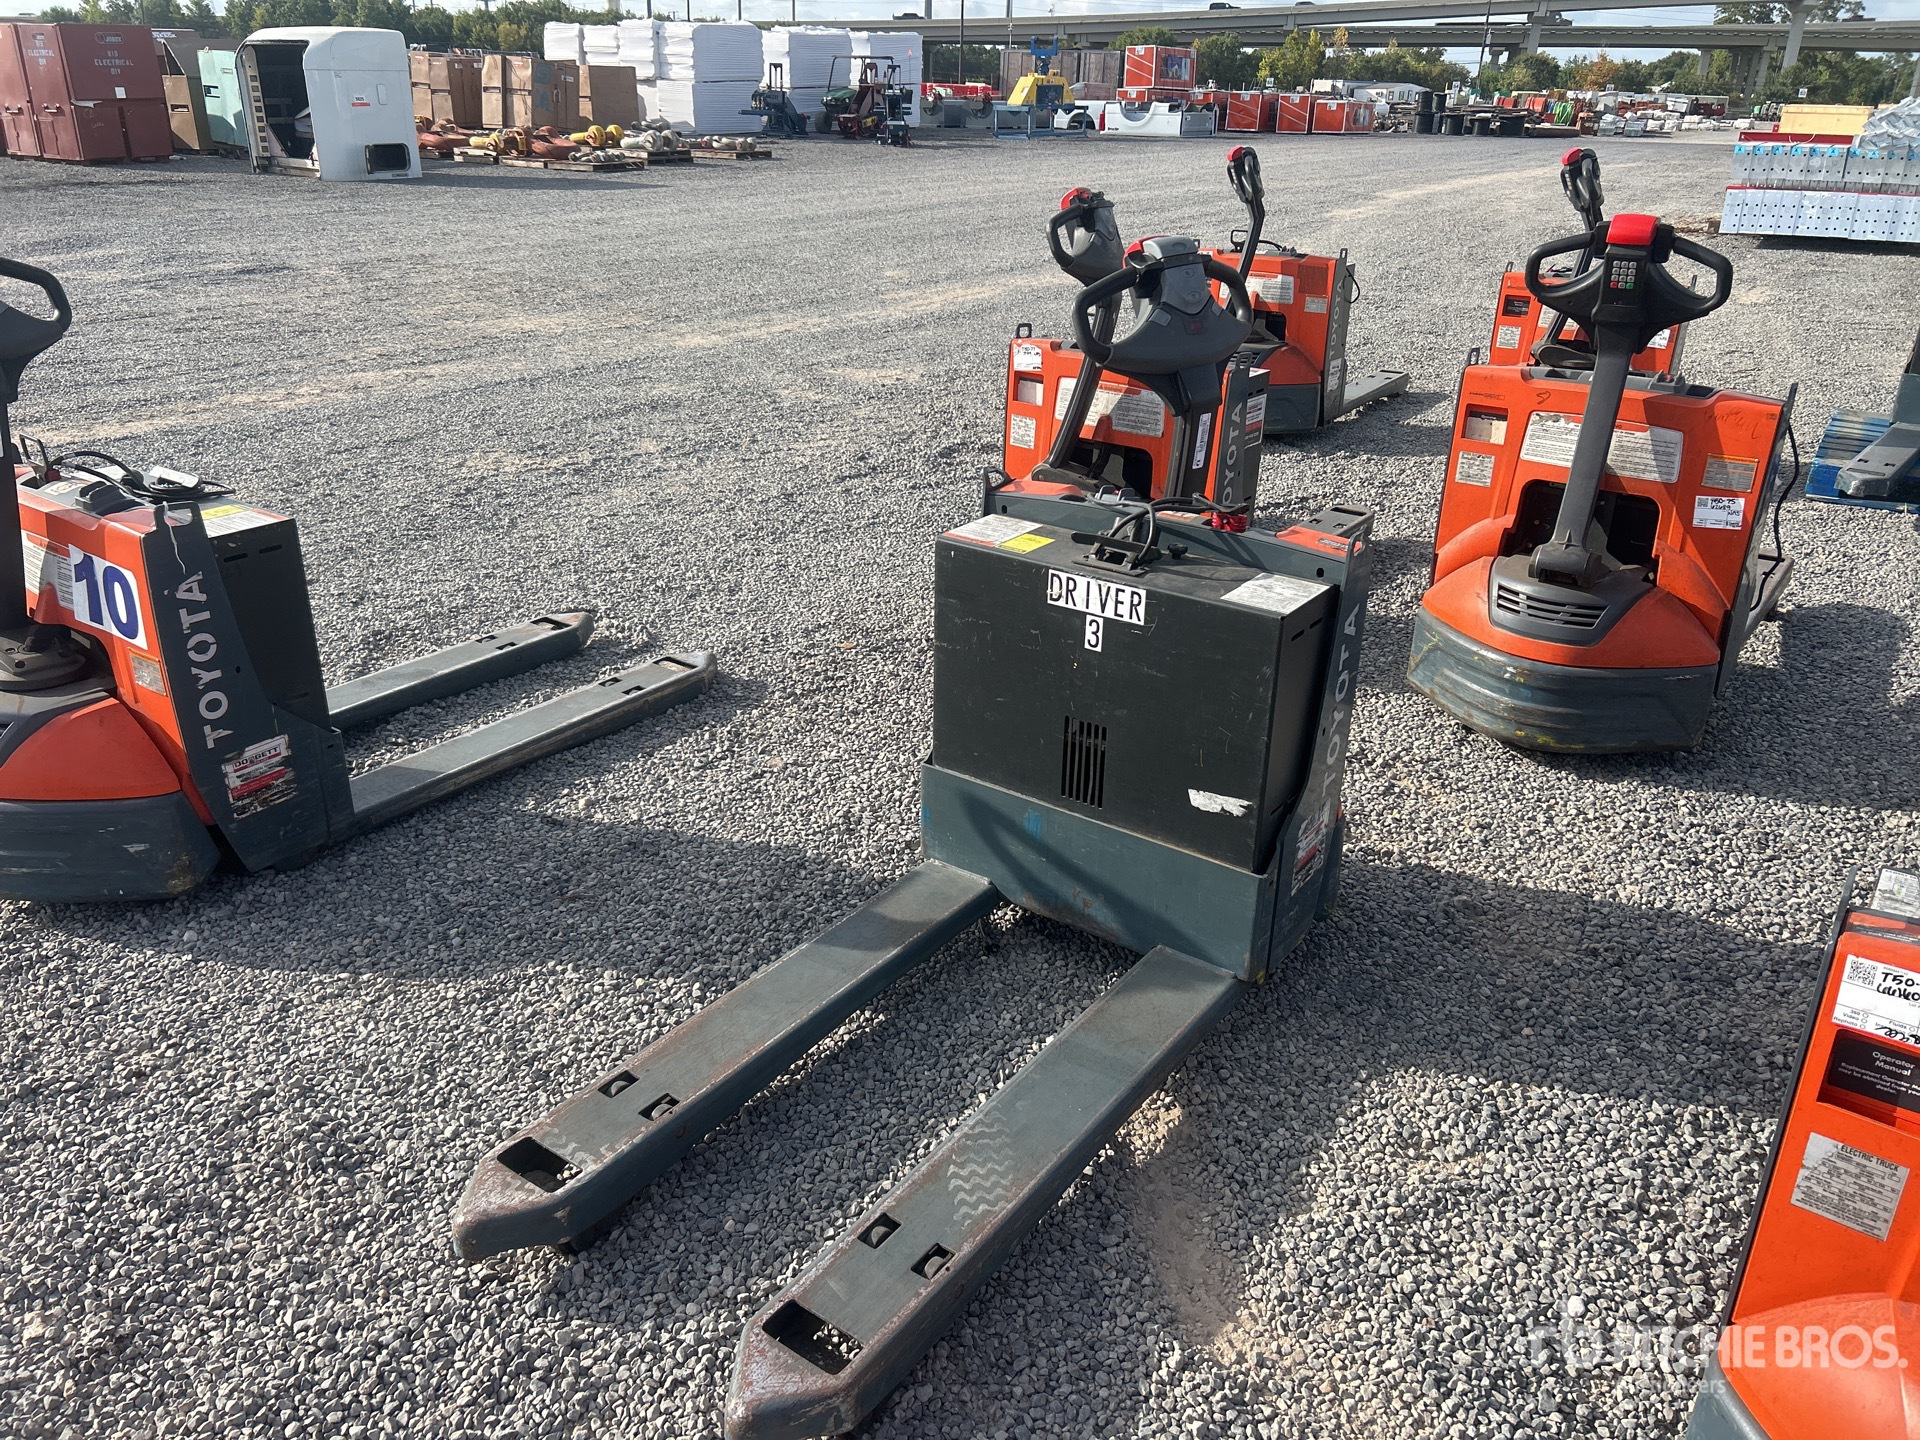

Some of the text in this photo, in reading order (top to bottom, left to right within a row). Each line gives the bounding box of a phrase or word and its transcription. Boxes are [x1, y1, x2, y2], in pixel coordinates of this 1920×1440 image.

[1329, 279, 1344, 359] TOYOTA
[1222, 402, 1243, 504] OYOTA
[74, 553, 139, 640] 10
[1049, 573, 1142, 622] DRIVER
[1087, 619, 1100, 648] 3
[175, 571, 234, 749] TOYOTA
[1322, 603, 1360, 797] TOYOTA
[234, 747, 279, 768] DOGETT
[1833, 1016, 1858, 1026] Rephoto
[1843, 1012, 1859, 1021] Video
[1889, 1021, 1907, 1029] Fluids
[1872, 1051, 1915, 1069] Operator
[1874, 1060, 1912, 1076] Manual
[1881, 1075, 1910, 1087] Operator
[1891, 1081, 1906, 1091] from
[1840, 1145, 1899, 1172] ELECTRIC TRUCK
